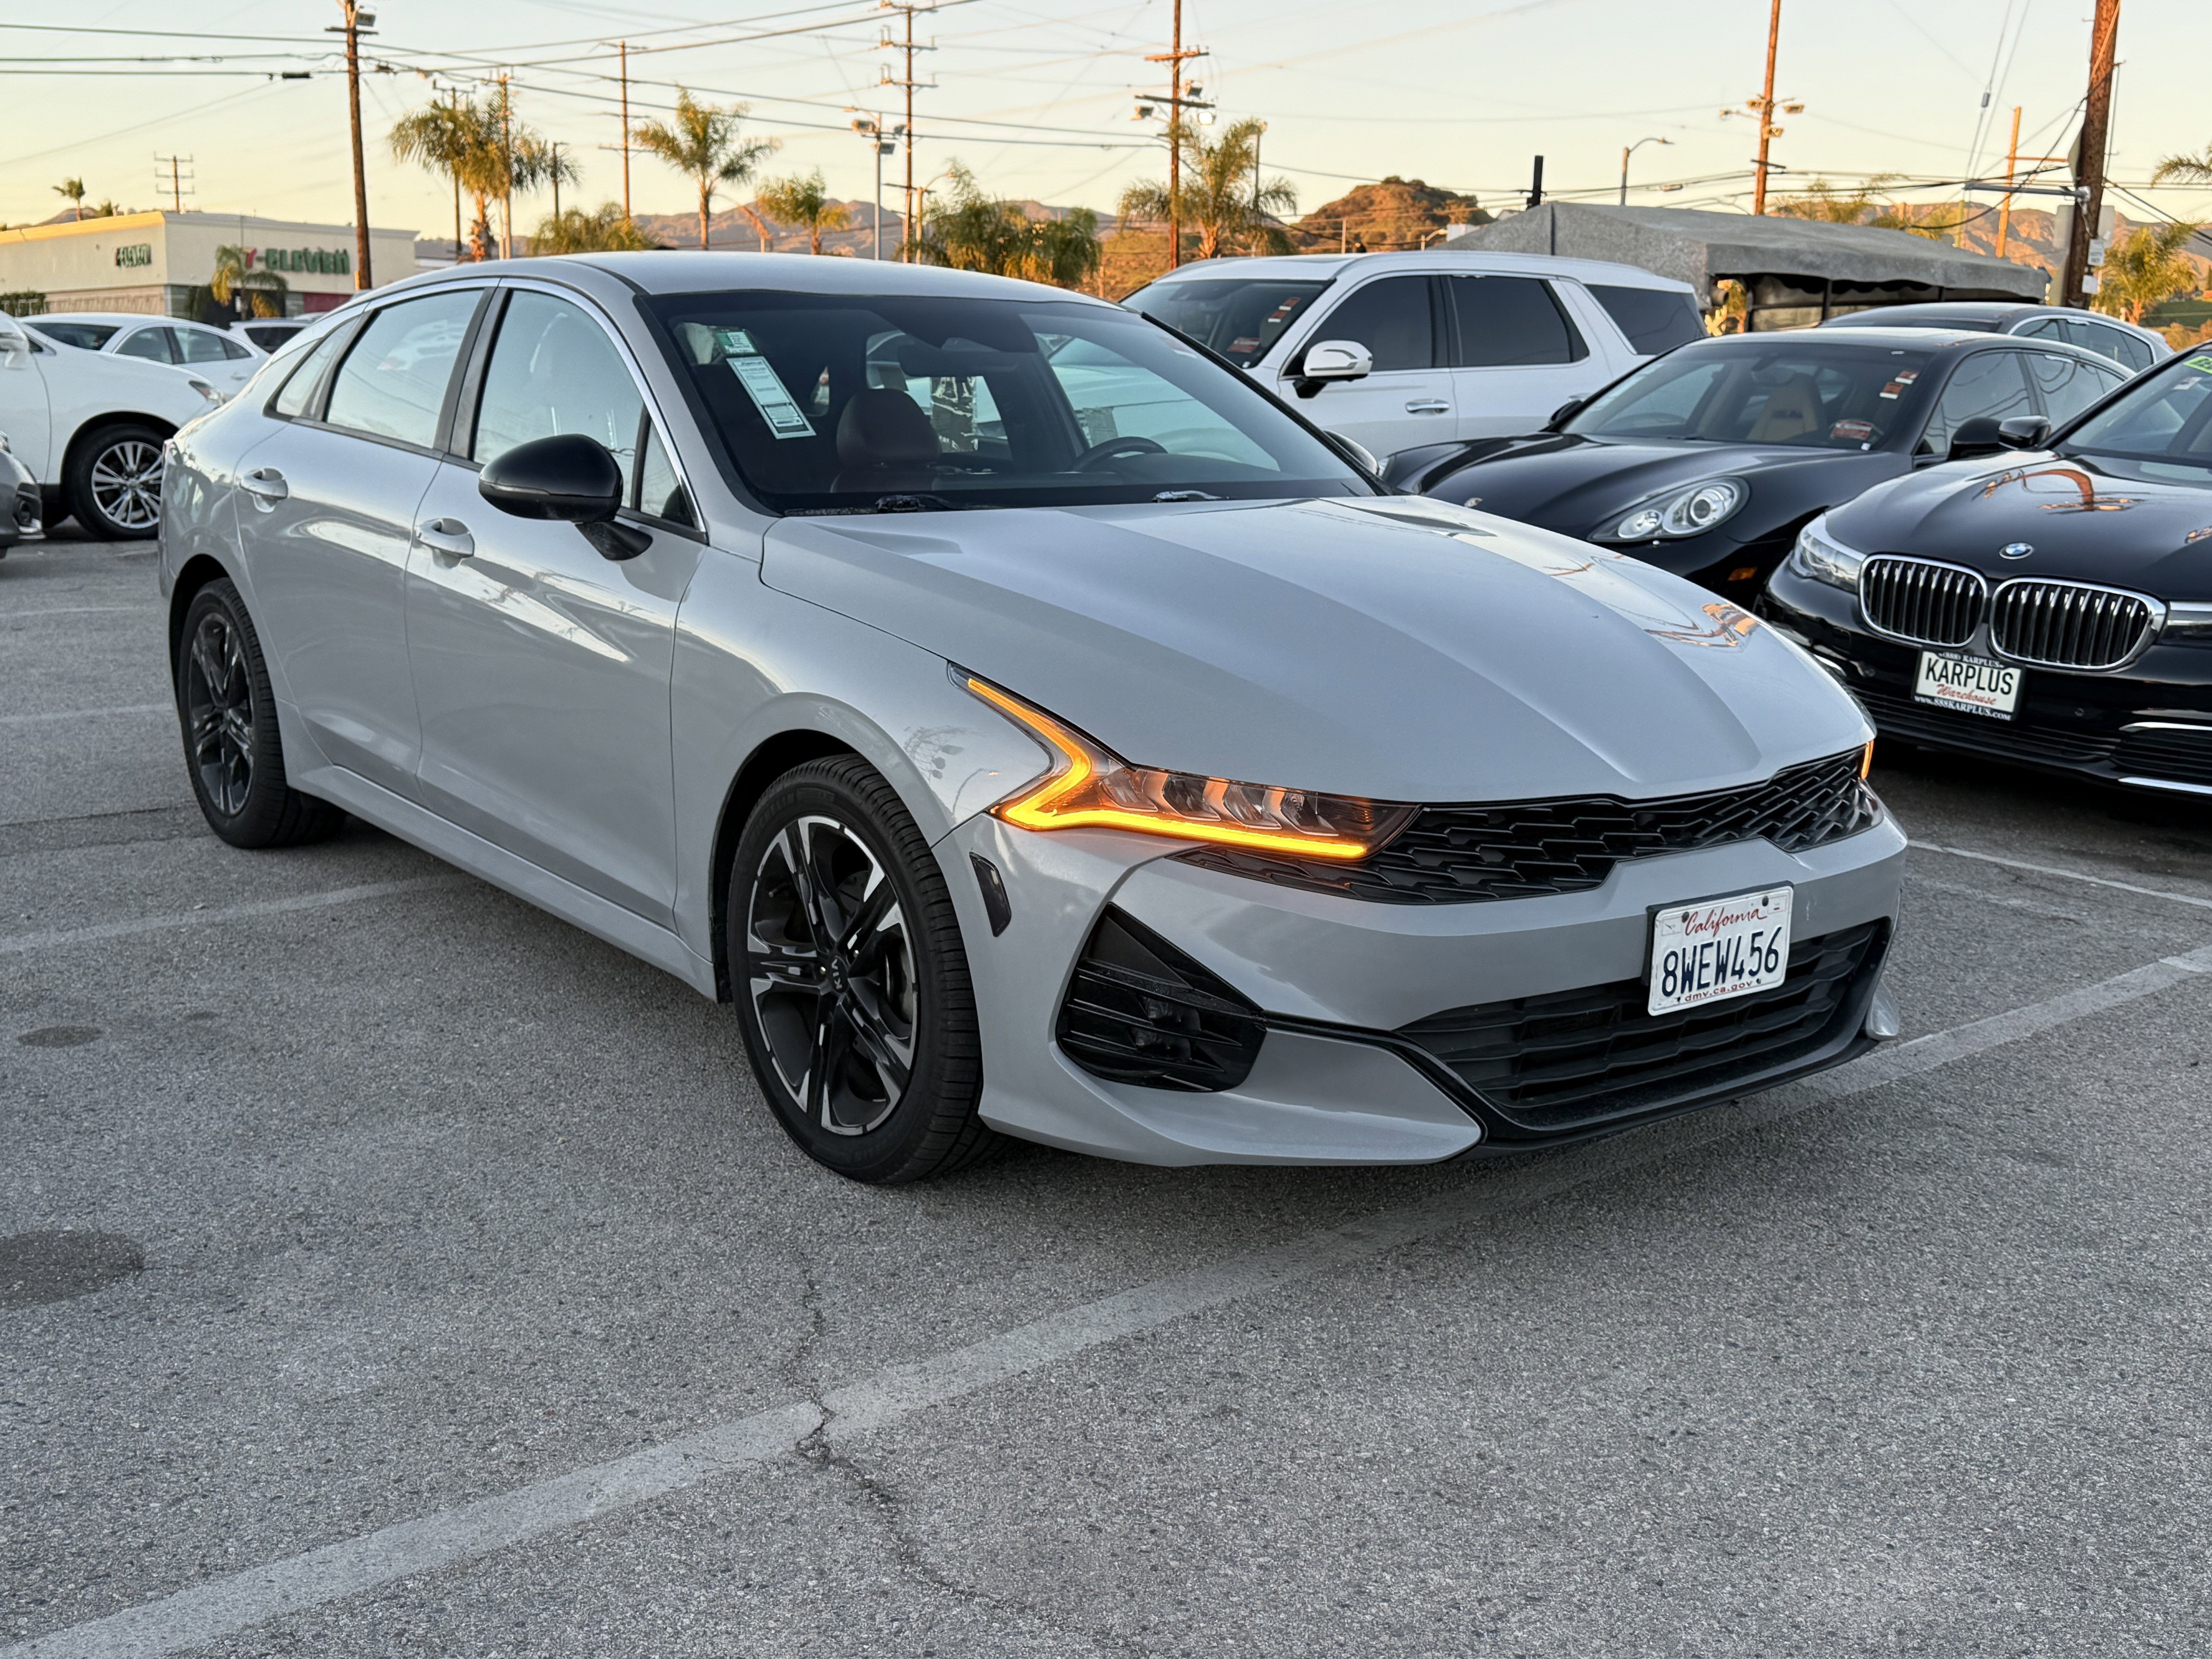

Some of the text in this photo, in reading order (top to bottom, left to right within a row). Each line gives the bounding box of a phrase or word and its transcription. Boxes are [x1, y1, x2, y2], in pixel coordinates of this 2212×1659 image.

[1925, 657, 2013, 695] KARPLUS
[1962, 654, 2000, 668] KARPLUS
[1936, 683, 1997, 705] Warehouse
[1685, 907, 1767, 937] California
[831, 958, 843, 990] KIA
[1661, 926, 1782, 997] 8WEW456
[1685, 980, 1753, 1002] dmv.ca.gov
